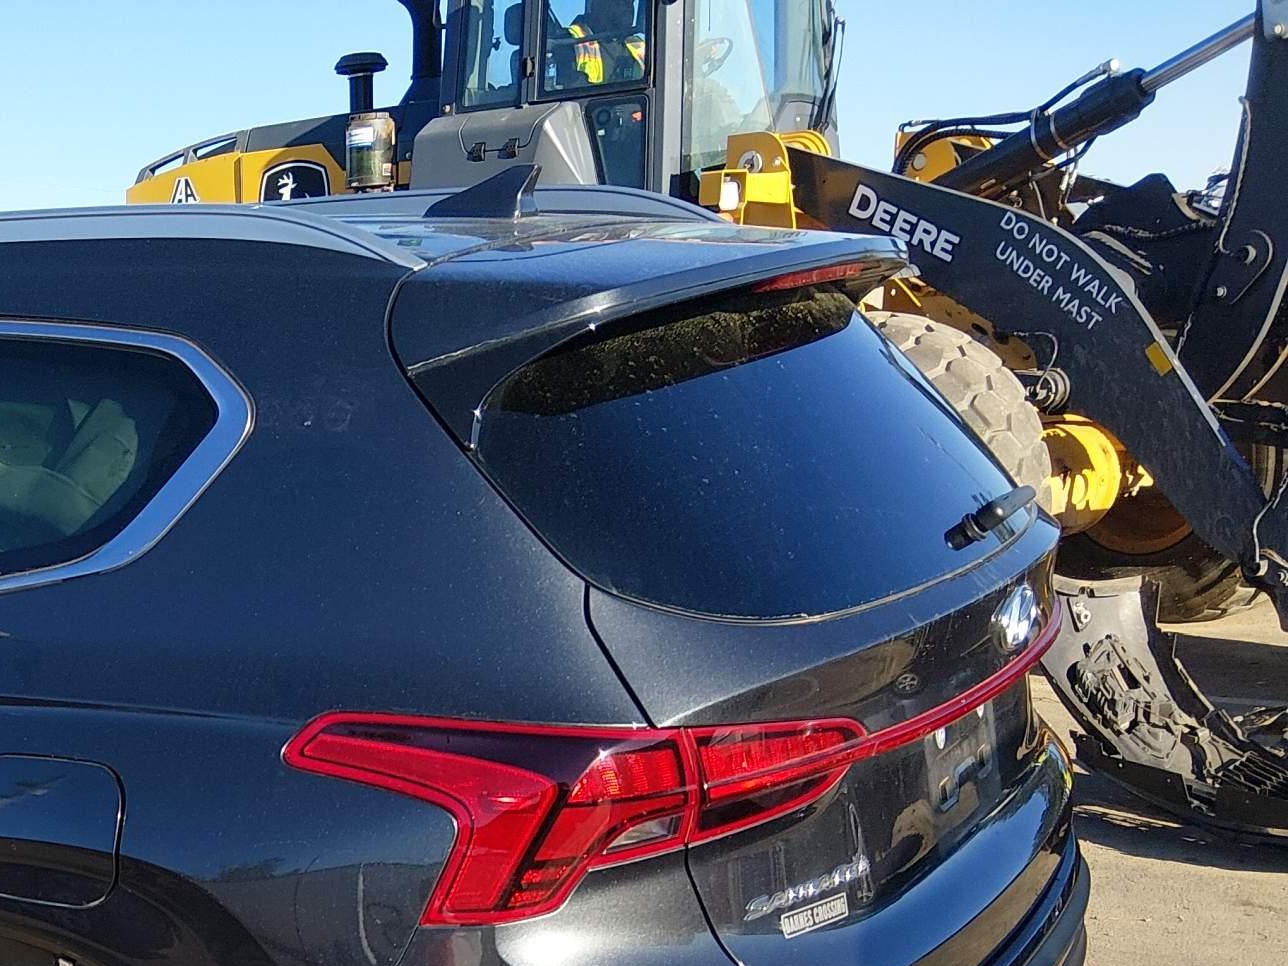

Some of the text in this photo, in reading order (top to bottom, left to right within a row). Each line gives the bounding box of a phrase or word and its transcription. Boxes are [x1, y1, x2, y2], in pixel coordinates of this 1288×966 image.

[847, 183, 961, 263] DEERE
[999, 210, 1123, 315] DO NOT WALK
[995, 240, 1104, 330] UNDER MAST
